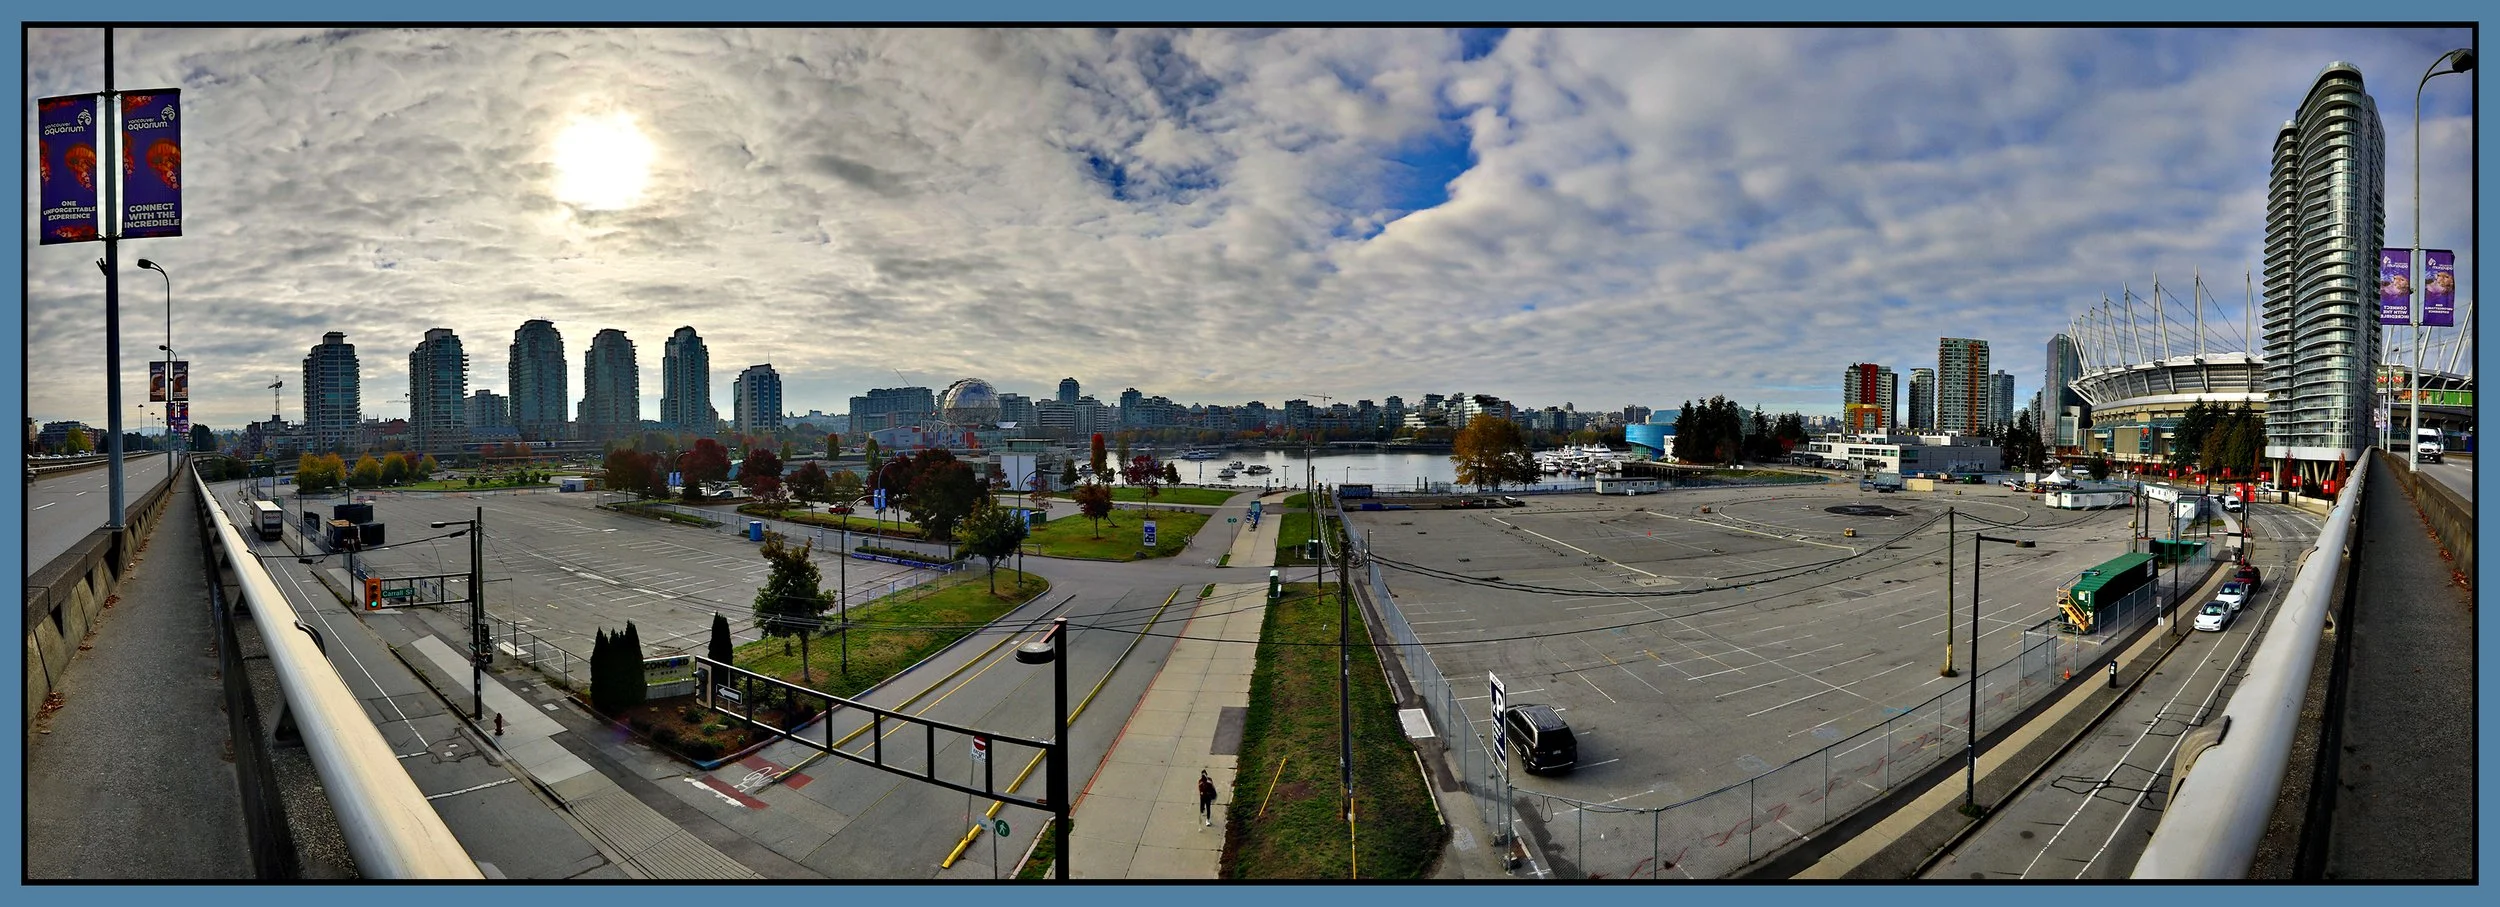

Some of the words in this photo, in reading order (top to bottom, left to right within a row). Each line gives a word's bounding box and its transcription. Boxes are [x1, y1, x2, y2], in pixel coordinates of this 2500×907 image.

[127, 121, 168, 130] aquarium
[44, 126, 85, 135] aquarium
[43, 206, 96, 215] UNFORGETTABLE
[129, 203, 175, 213] CONNECT
[48, 213, 91, 221] EXPERIENCE
[129, 212, 155, 221] WITH
[156, 211, 176, 219] THE
[124, 219, 180, 229] INCREDIBLE
[1495, 689, 1504, 718] P
